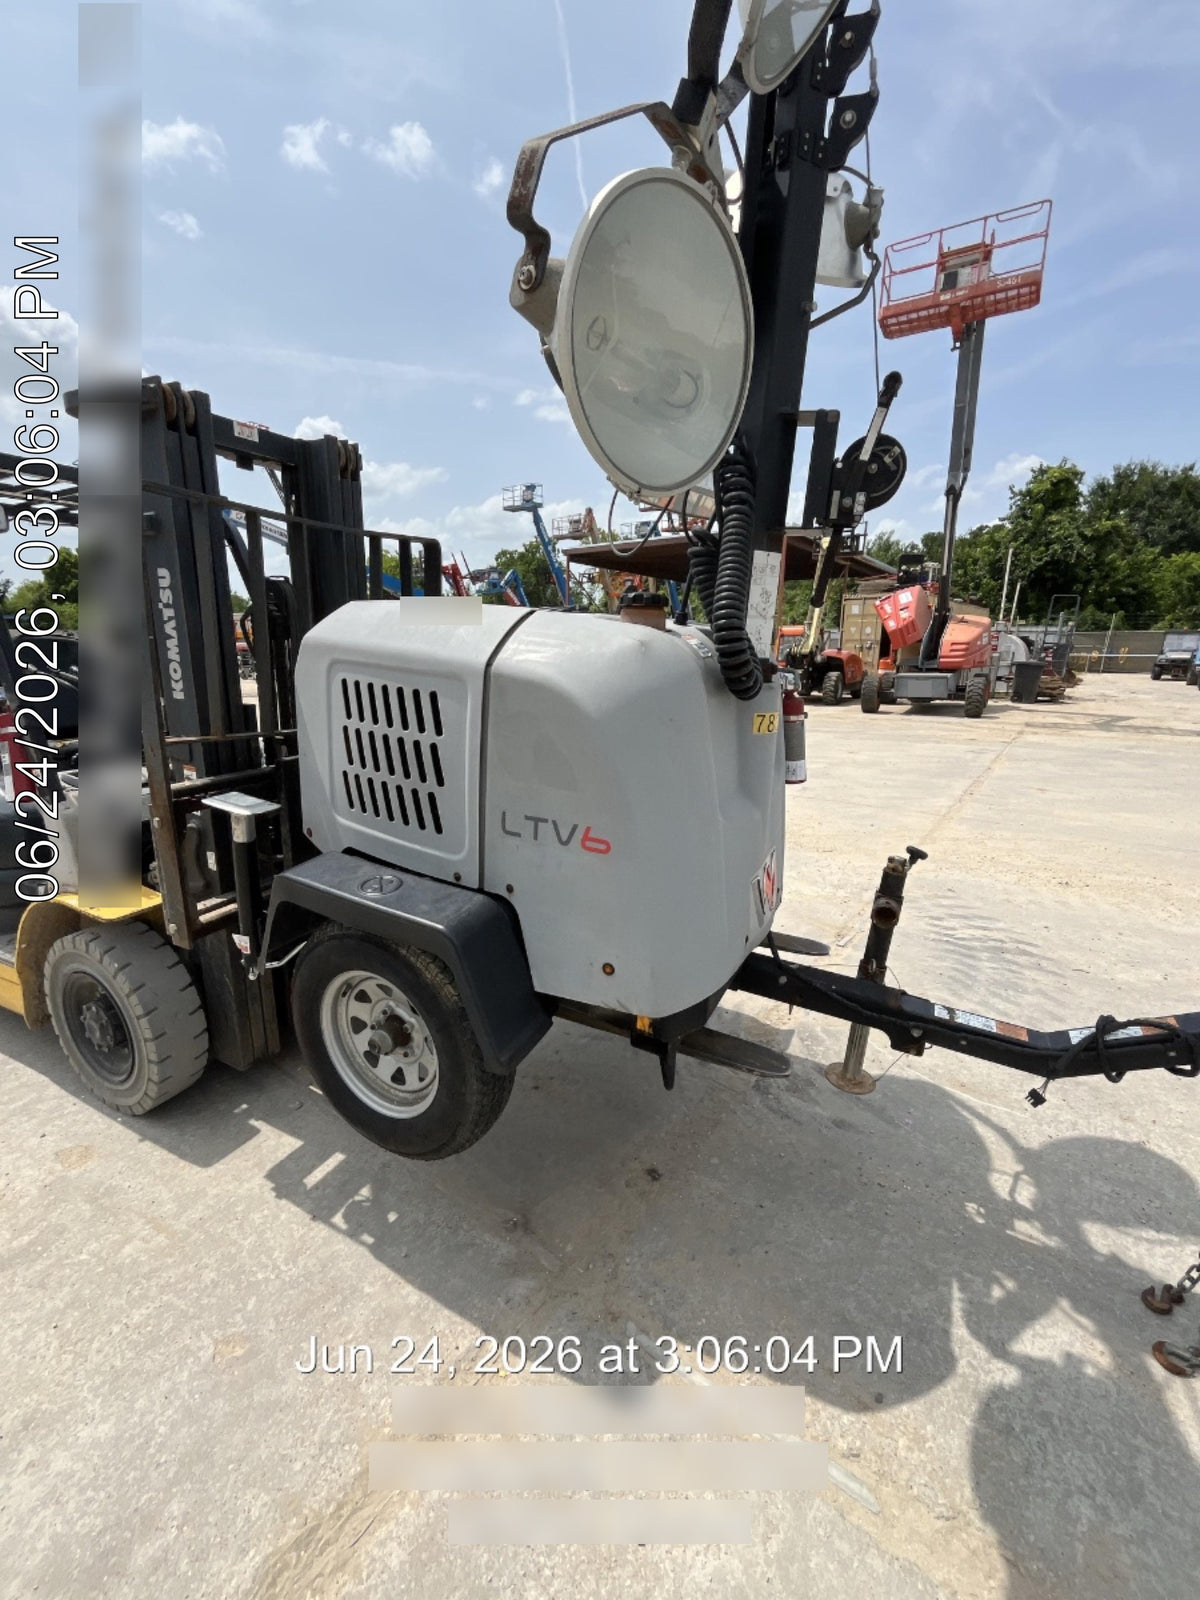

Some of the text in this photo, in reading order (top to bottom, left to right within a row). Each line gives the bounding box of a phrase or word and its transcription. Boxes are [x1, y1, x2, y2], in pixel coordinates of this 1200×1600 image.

[157, 567, 184, 699] KOMATSU
[756, 714, 776, 733] 78
[501, 811, 612, 855] LTV6
